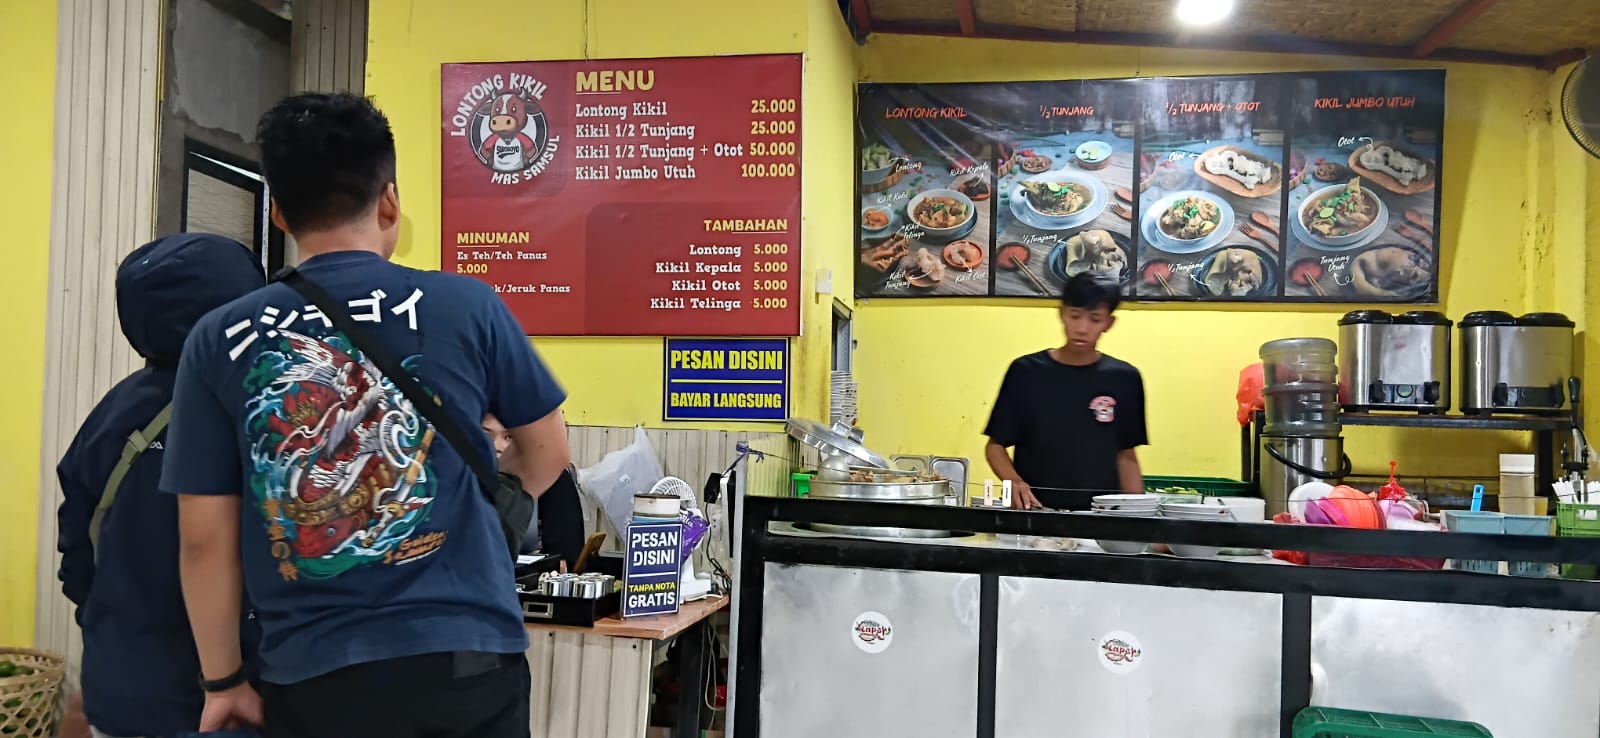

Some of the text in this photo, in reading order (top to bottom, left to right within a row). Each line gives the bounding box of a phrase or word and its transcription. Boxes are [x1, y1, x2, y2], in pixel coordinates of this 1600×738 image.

[576, 70, 655, 92] MENU
[451, 73, 547, 136] LONTONG KIKIL
[576, 99, 795, 120] Lontong Kikil 25.000
[1180, 102, 1223, 114] TUNJANG
[1235, 101, 1261, 112] OTOT
[1314, 96, 1416, 109] KIKIL JUMBO UTUH
[885, 106, 968, 119] LONTONG KIKIL
[1051, 106, 1095, 116] TUNJANG
[576, 120, 795, 140] Kikil 1/2 Tunjang 25.000
[576, 142, 795, 161] Kikil 1/2 Tunjang + Otot 50.000
[491, 136, 560, 185] MAS SAMSUL
[576, 163, 795, 180] Kikil Jumbo Utuh 100.000
[703, 219, 788, 231] TAMBAHAN
[457, 231, 530, 244] MINUMAN
[457, 251, 548, 260] Es Teh/Teh Panas
[689, 244, 788, 257] Lontong 5.000
[456, 263, 488, 274] 5.000
[655, 261, 788, 275] Kikil Kepala 5.000
[491, 284, 571, 294] k/Jeruk Panas
[672, 279, 788, 291] Kikil Otot 5.000
[650, 297, 788, 311] Kikil Telinga 5.000
[670, 350, 783, 370] PESAN DISINI
[670, 392, 782, 409] BAYAR LANGSUNG
[632, 532, 678, 549] PESAN
[633, 549, 675, 567] DISINI
[628, 582, 676, 593] TANPA NOTA
[628, 592, 676, 608] GRATIS
